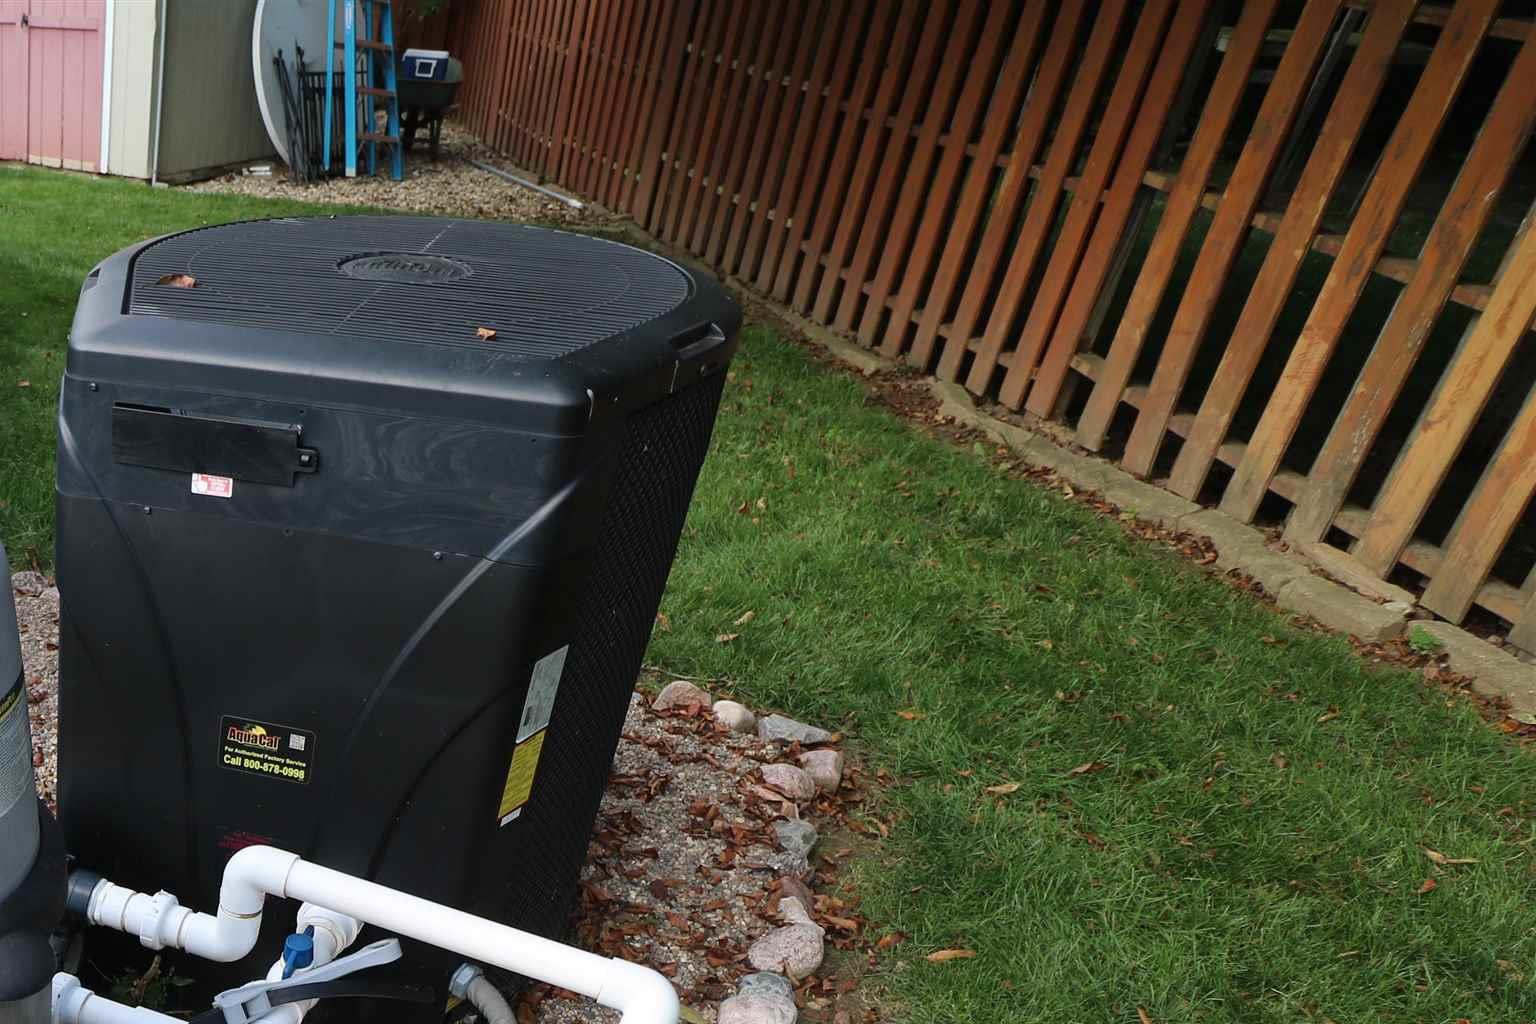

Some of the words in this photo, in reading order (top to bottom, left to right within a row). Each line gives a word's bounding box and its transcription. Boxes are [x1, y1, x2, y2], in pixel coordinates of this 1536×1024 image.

[226, 726, 281, 750] AquaCal
[223, 754, 242, 766] Call
[243, 758, 305, 779] 800-878-0998
